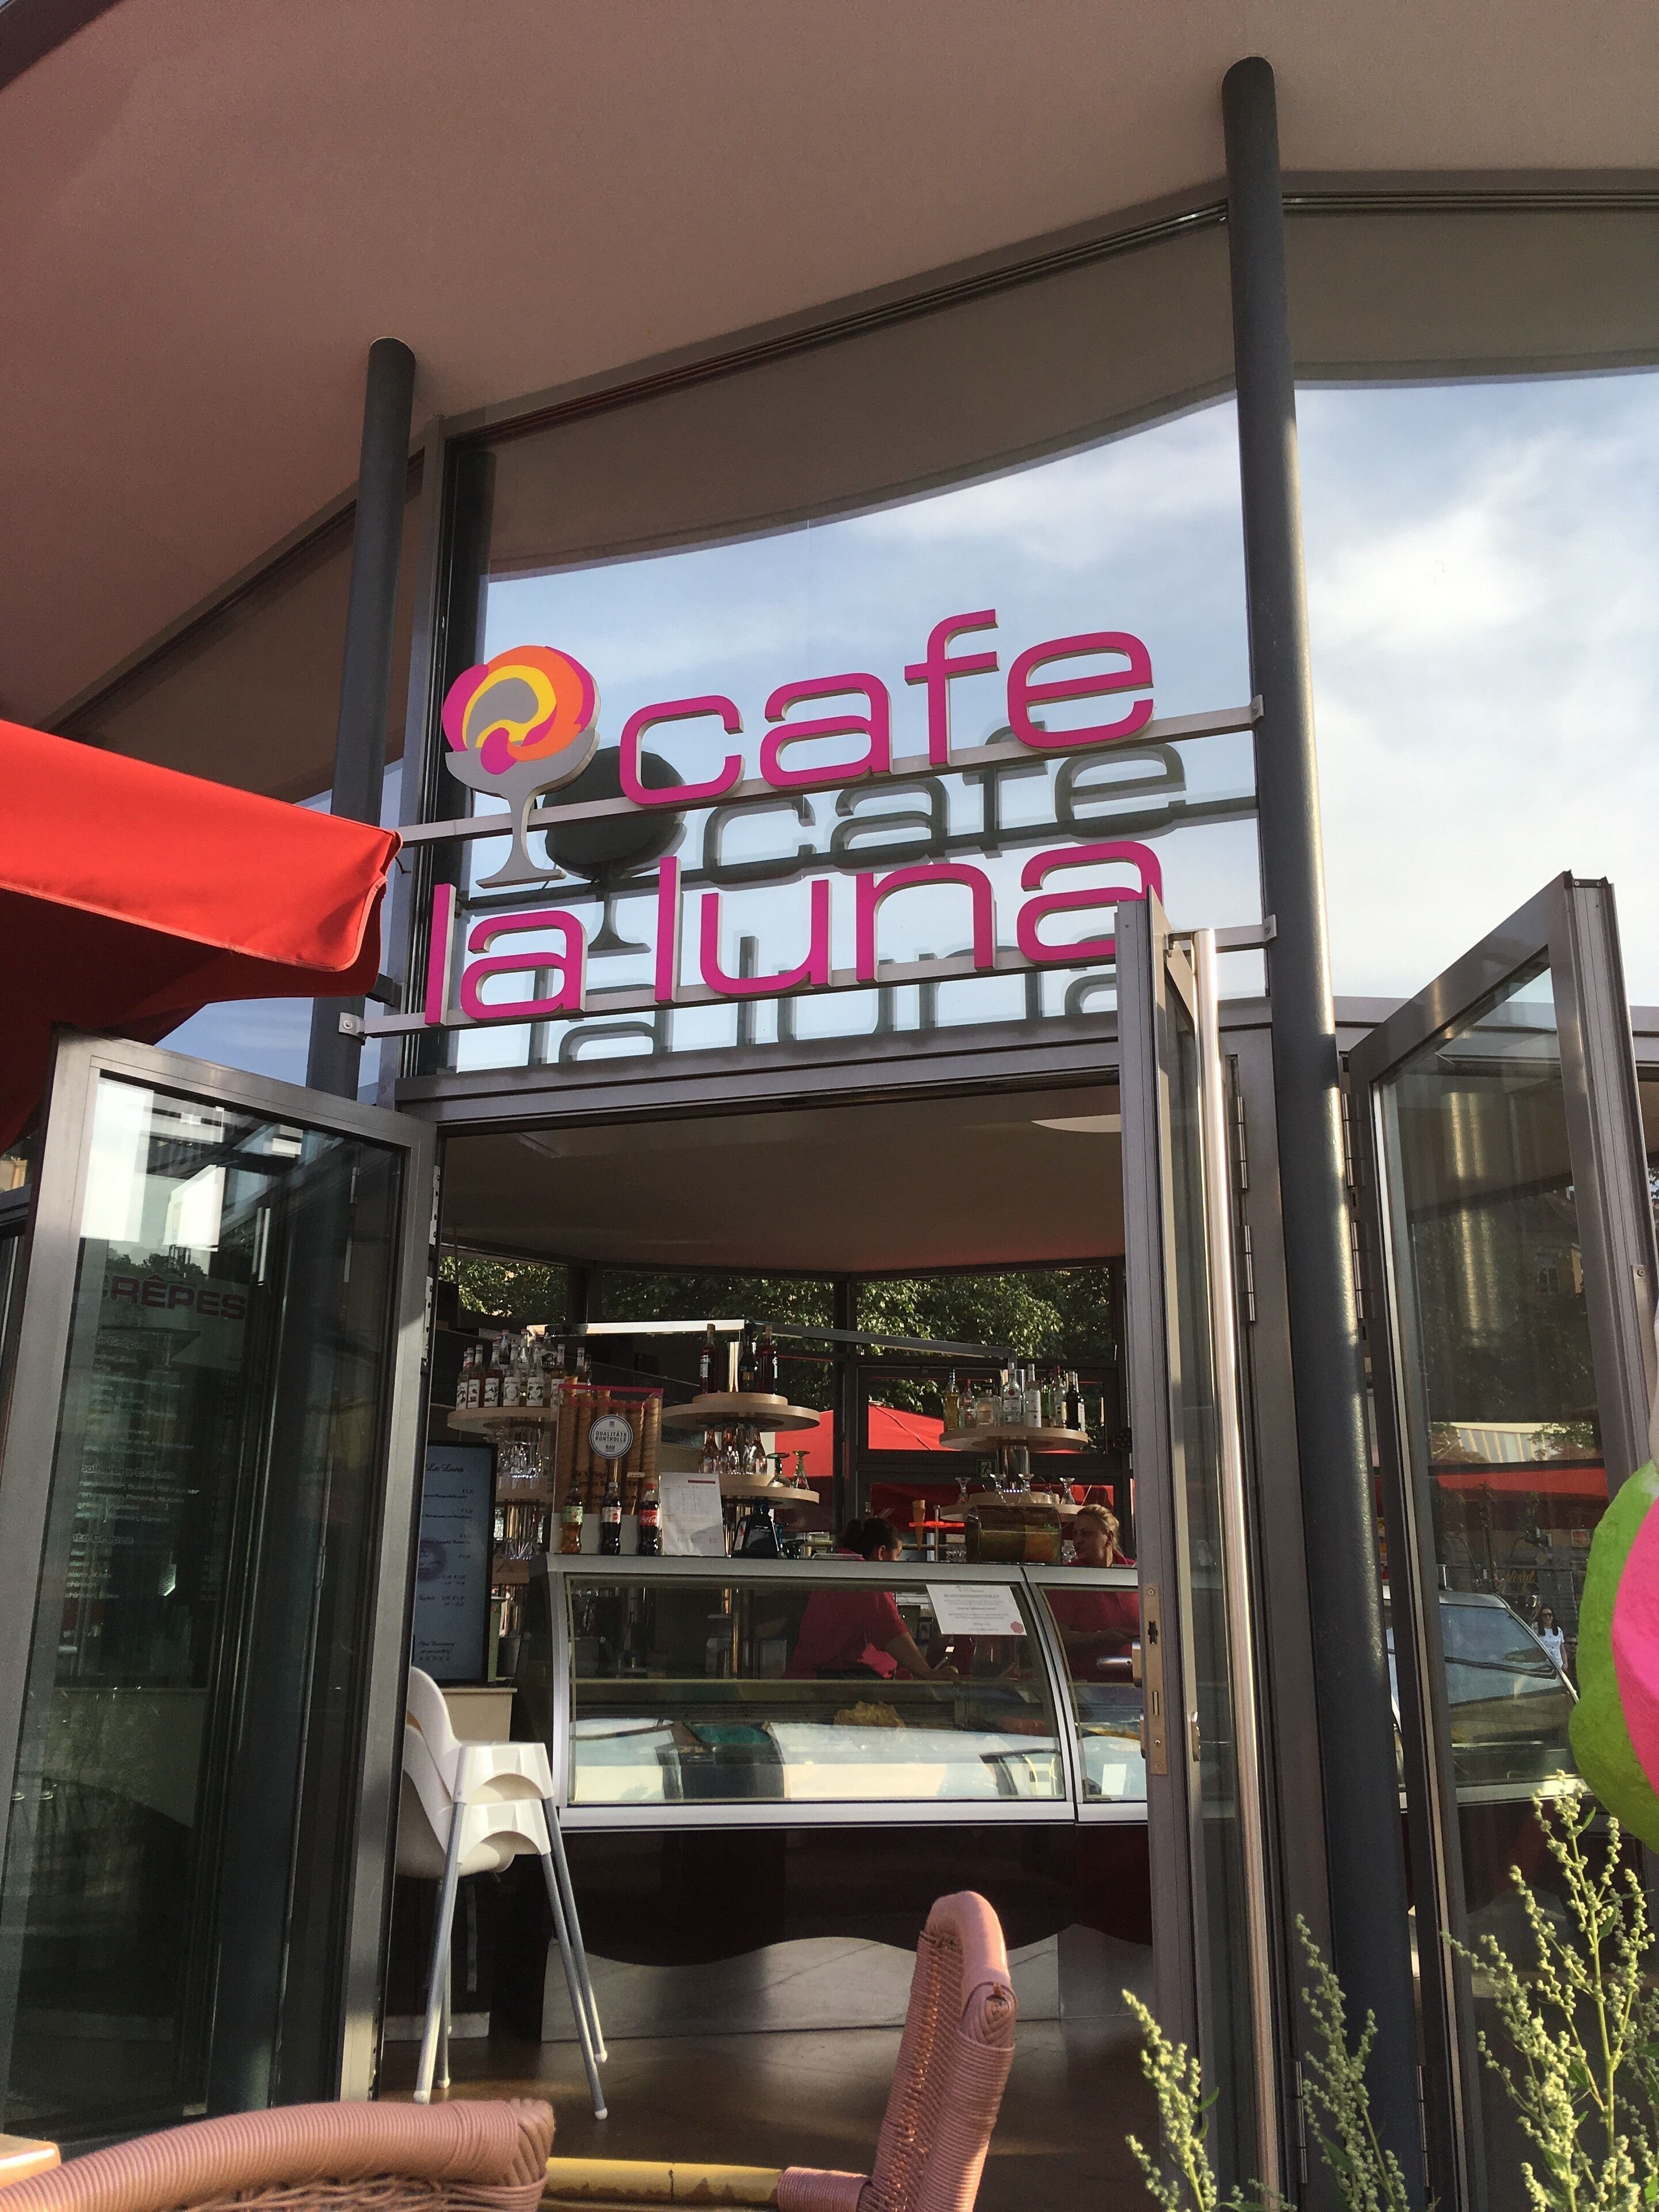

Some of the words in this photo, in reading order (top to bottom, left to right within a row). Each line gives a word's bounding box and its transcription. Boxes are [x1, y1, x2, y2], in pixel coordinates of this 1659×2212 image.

[619, 609, 1154, 805] cafe
[424, 882, 590, 1026] la
[654, 840, 1162, 1005] luna
